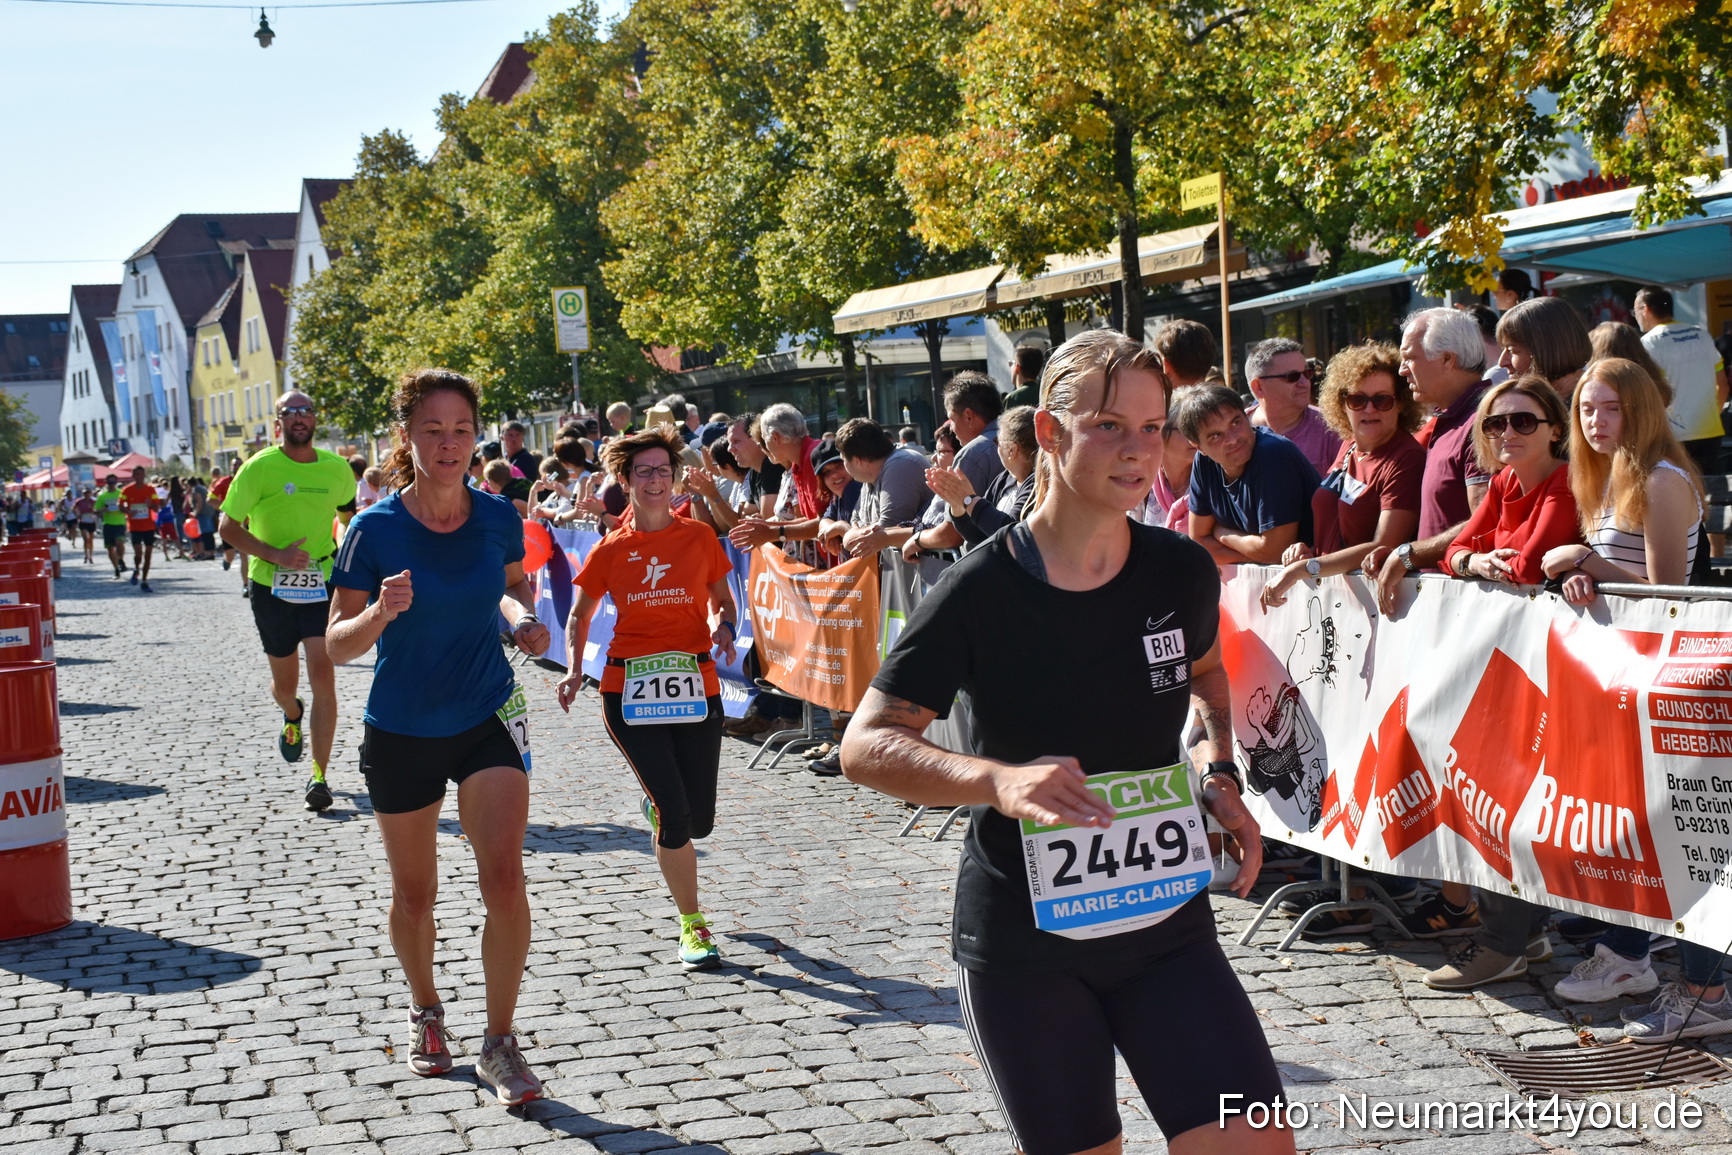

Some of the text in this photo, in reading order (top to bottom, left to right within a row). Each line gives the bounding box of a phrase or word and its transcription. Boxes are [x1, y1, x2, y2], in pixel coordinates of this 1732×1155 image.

[1188, 184, 1219, 201] Toiletten
[1553, 169, 1632, 201] vodafo
[279, 573, 318, 588] 2235
[831, 573, 855, 583] Partner
[277, 590, 322, 598] CHRISTIAN
[627, 587, 686, 605] funrunners
[645, 596, 694, 608] neumarkt
[839, 617, 865, 631] angeht.
[1151, 633, 1182, 659] BRL
[631, 655, 694, 676] BOCK
[632, 676, 695, 700] 2161
[1618, 685, 1629, 709] Seit
[634, 704, 695, 716] BRIGITTE
[1656, 699, 1732, 720] RUNDSCHL
[1531, 711, 1548, 754] Seit 1929
[1667, 773, 1707, 792] Braun
[1374, 769, 1432, 834] Braun
[1442, 743, 1507, 844] Braun
[1672, 794, 1693, 812] Am
[1401, 813, 1421, 830] Sicher
[1420, 806, 1429, 819] ist
[1531, 774, 1644, 862] Braun
[1674, 815, 1730, 835] D-92318
[1465, 814, 1481, 839] Sicher
[1482, 832, 1491, 847] ist
[1047, 819, 1196, 888] 2449 D
[1681, 844, 1708, 862] Tel.
[1575, 860, 1665, 889] Sicher ist sicher
[1687, 865, 1712, 884] Fax
[1052, 877, 1198, 919] MARIE-CLAIRE
